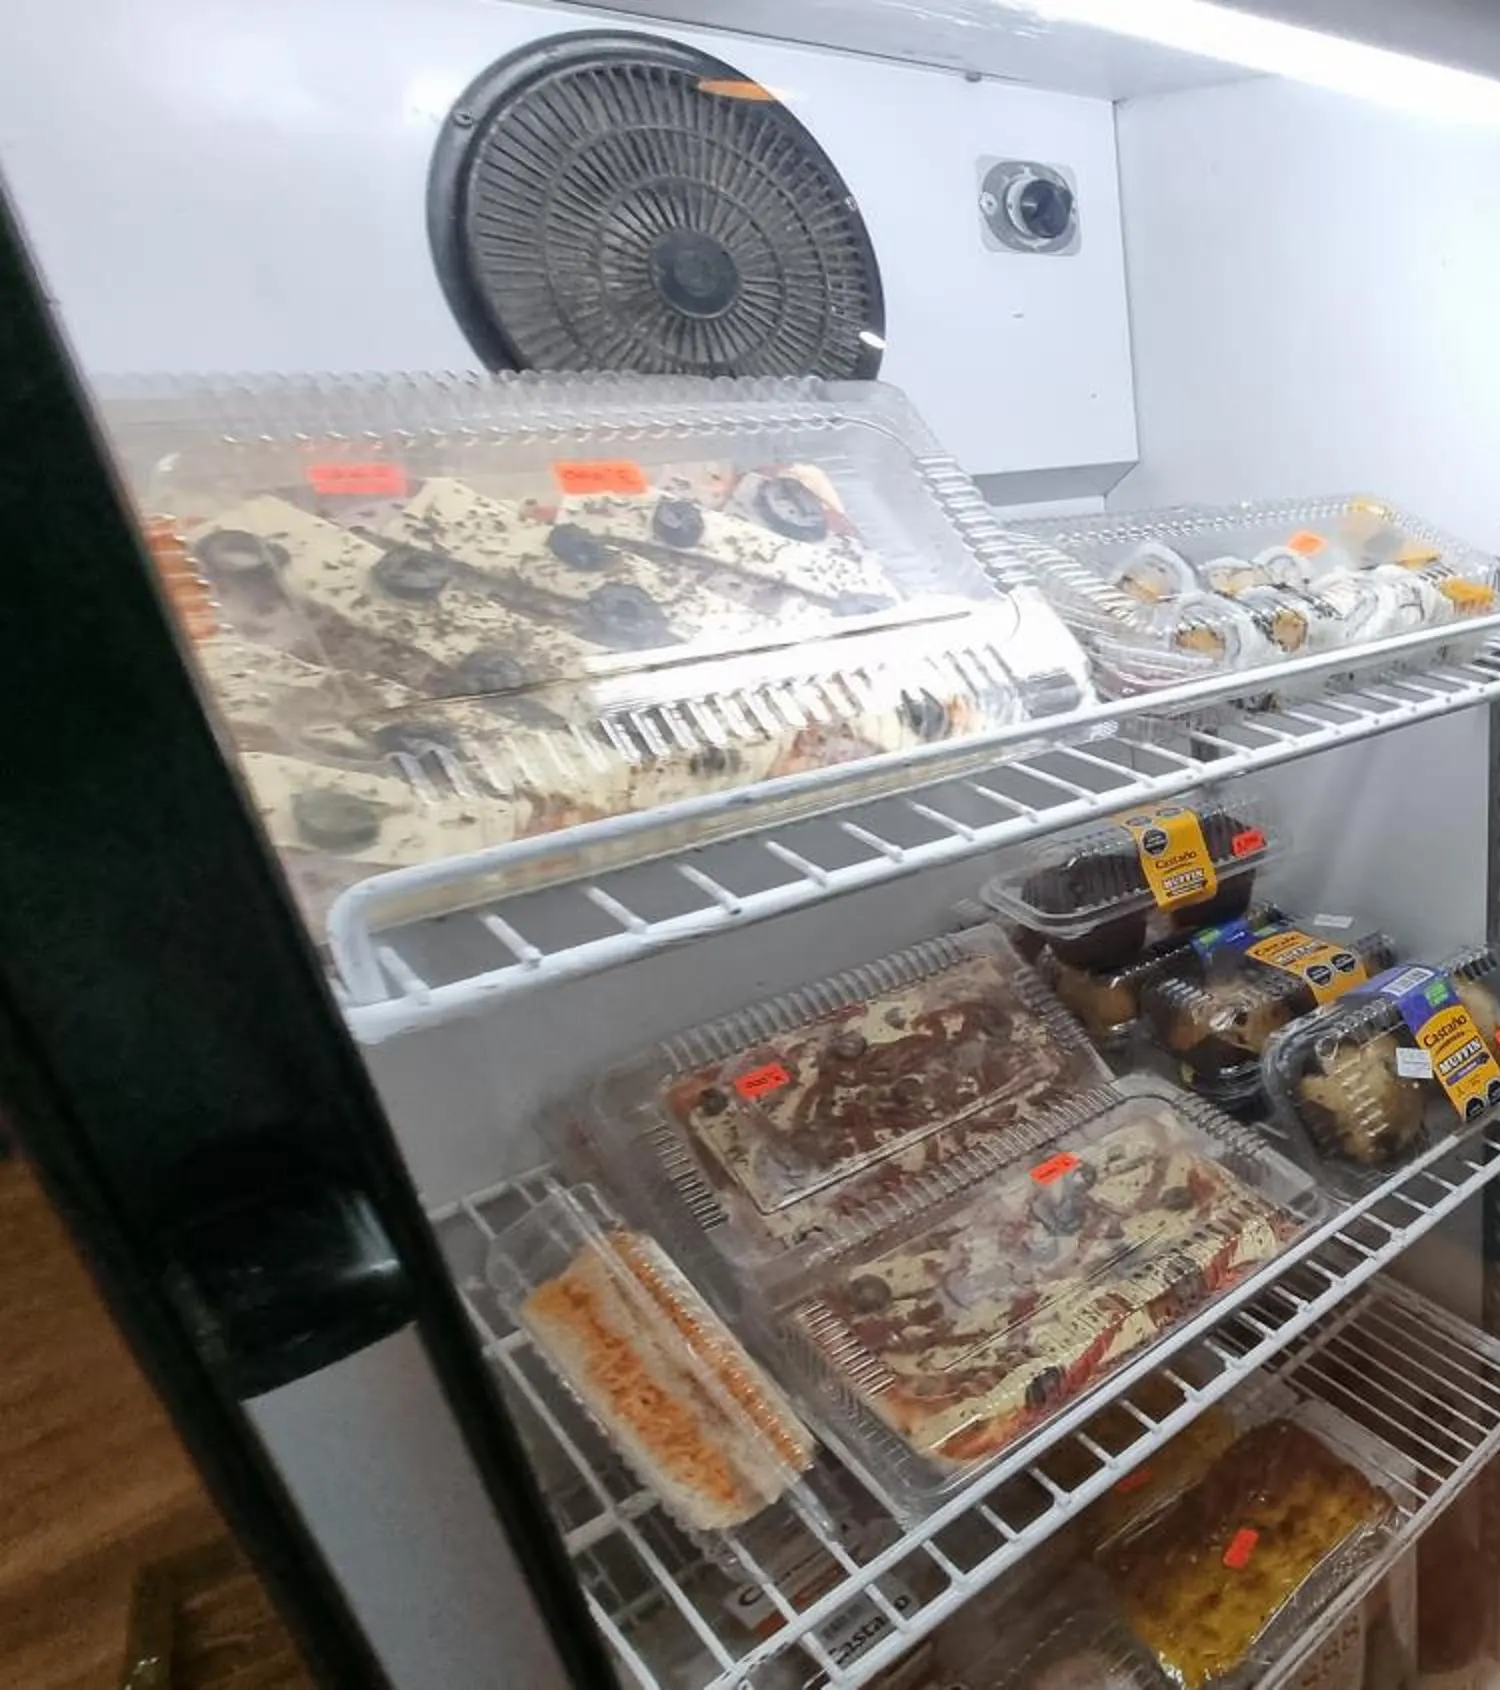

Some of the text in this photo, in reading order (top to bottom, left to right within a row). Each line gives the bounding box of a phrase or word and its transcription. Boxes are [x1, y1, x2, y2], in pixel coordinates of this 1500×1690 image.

[1423, 1014, 1468, 1048] Castaño
[1438, 1035, 1482, 1076] MUFFIN
[827, 1594, 910, 1665] astao
